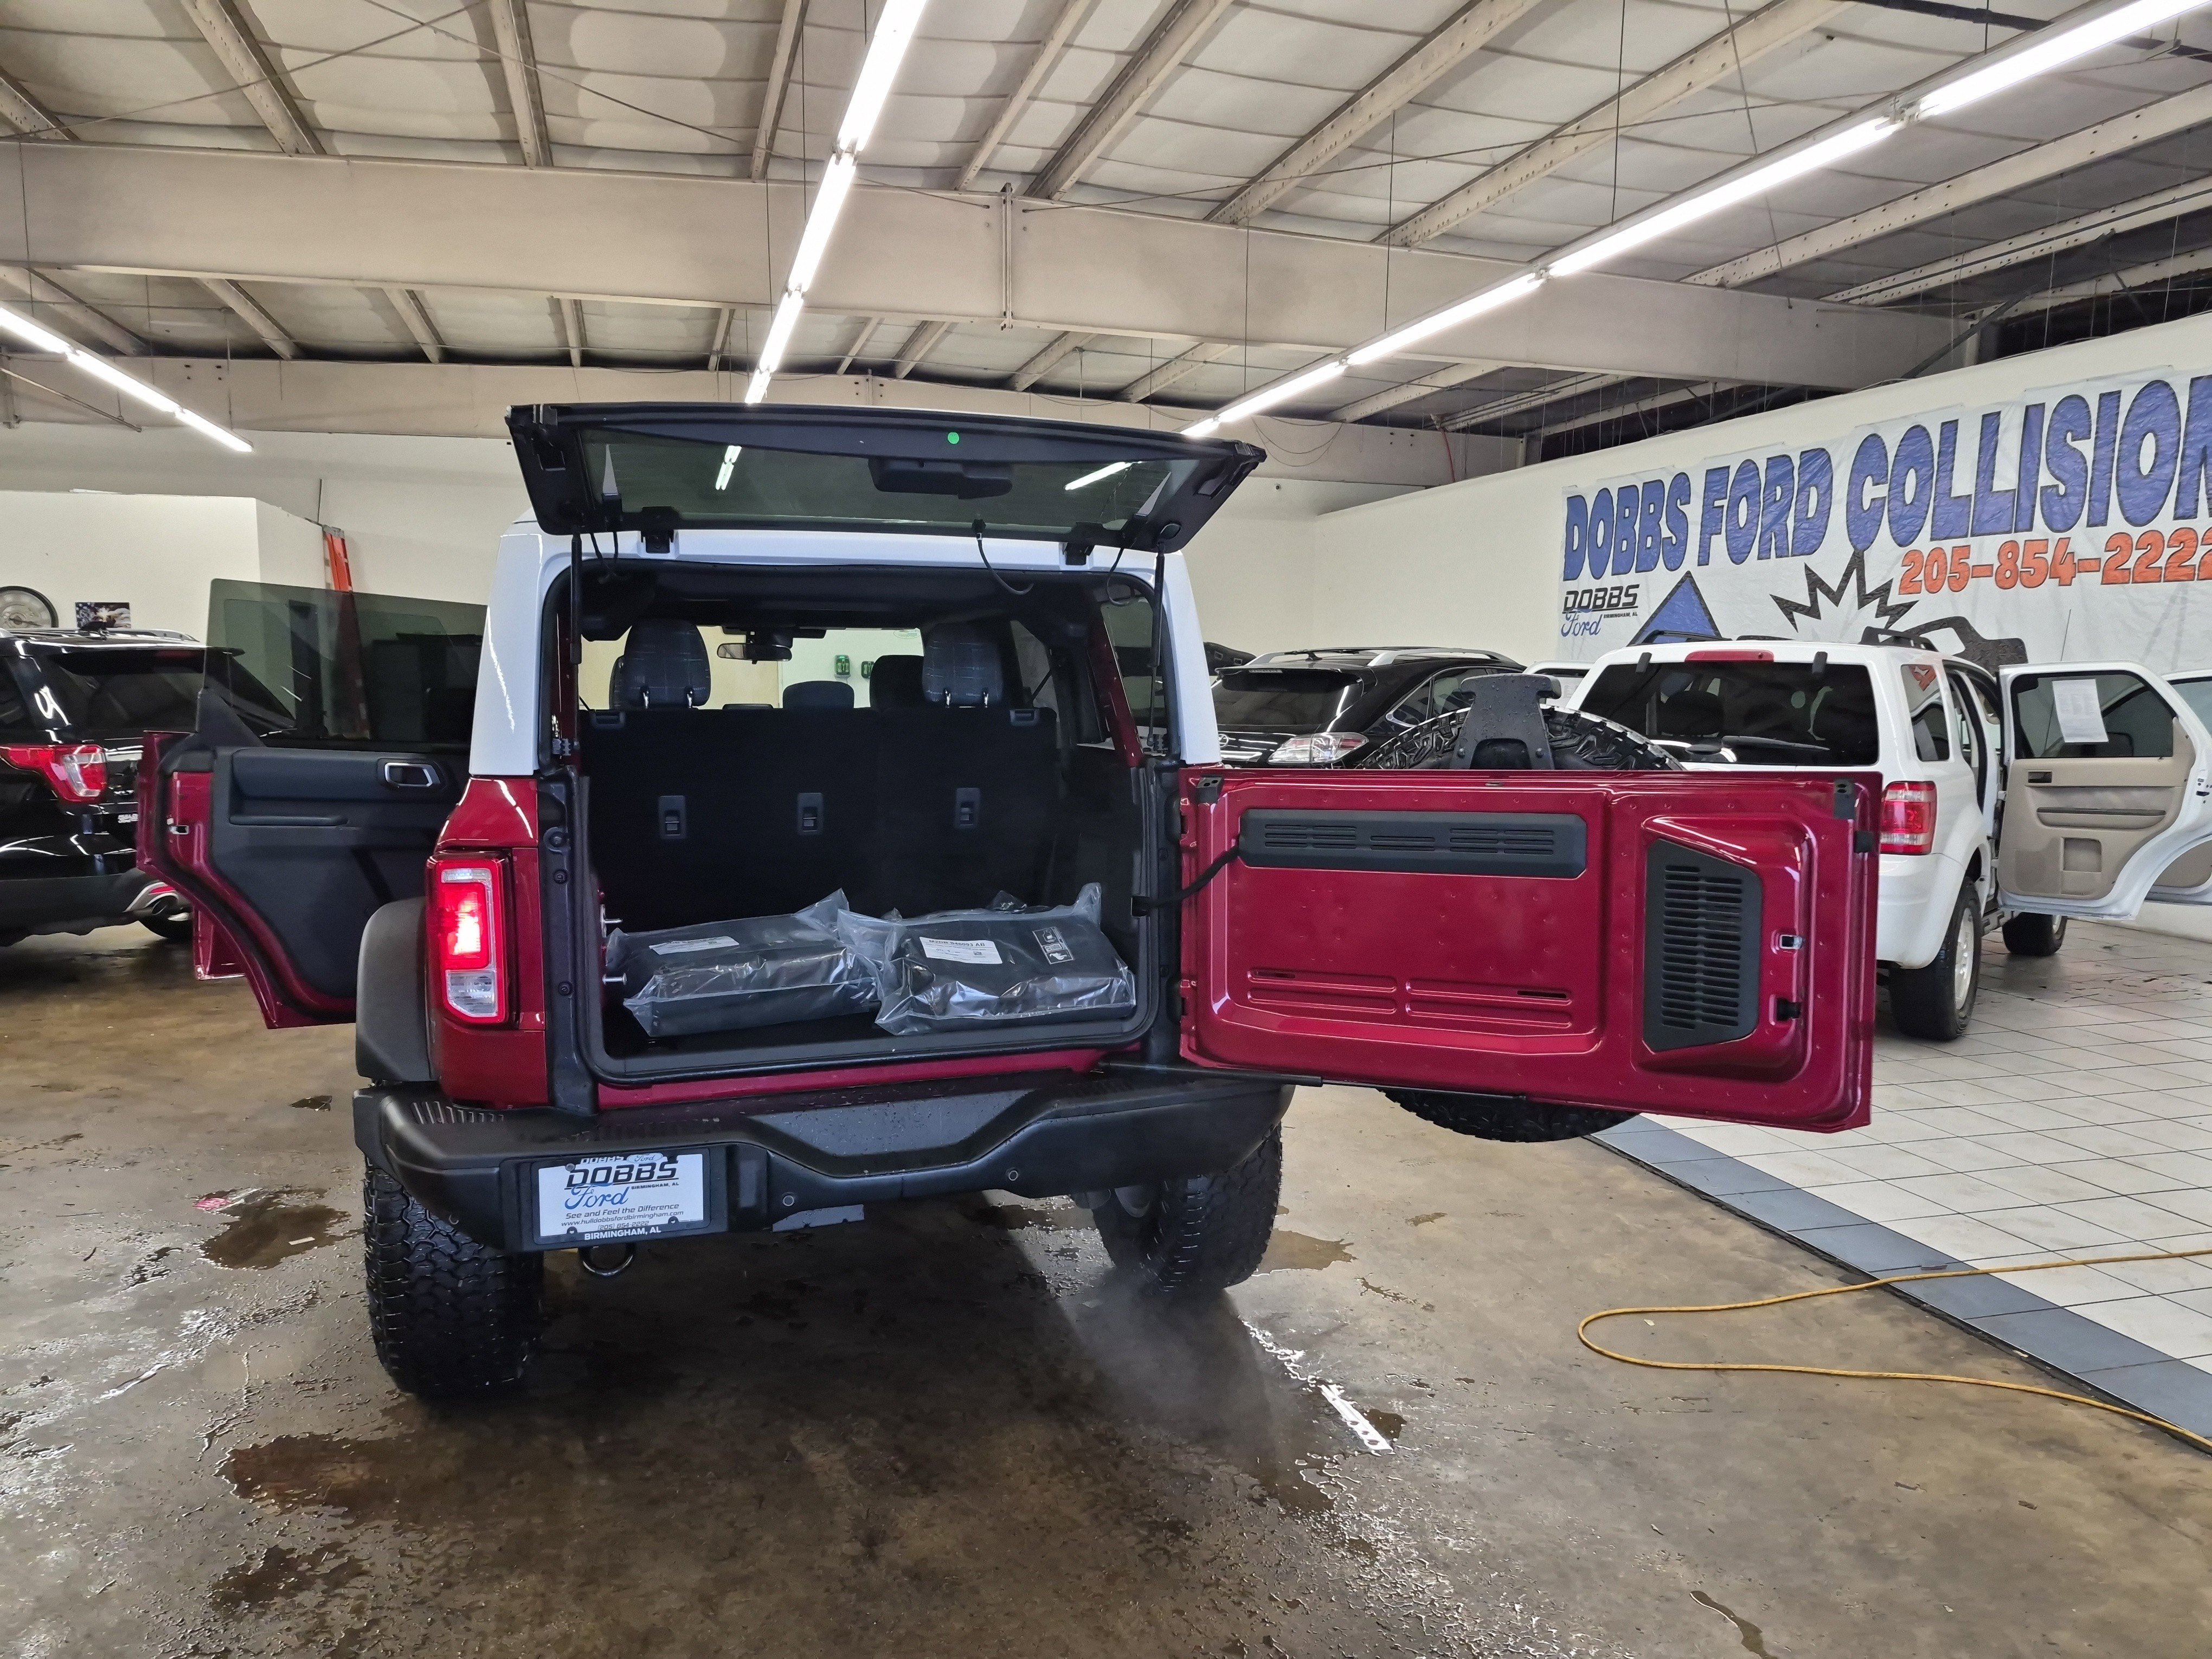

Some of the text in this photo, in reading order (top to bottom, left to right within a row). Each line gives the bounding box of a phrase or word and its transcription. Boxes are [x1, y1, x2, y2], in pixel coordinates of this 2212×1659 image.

[1563, 375, 2212, 582] DOBBS FORD COLLISION
[1563, 584, 1640, 611] DOBBS
[1561, 607, 1603, 636] Ford
[634, 1154, 654, 1162] Ford
[566, 1161, 679, 1188] DOBBS
[564, 1182, 631, 1210] Ford
[561, 1211, 684, 1226] www.hulldobbsfordbirmingham.com
[638, 1204, 679, 1212] Difference
[584, 1226, 662, 1240] BIRMINGHAM, AL
[597, 1223, 615, 1231] (205)
